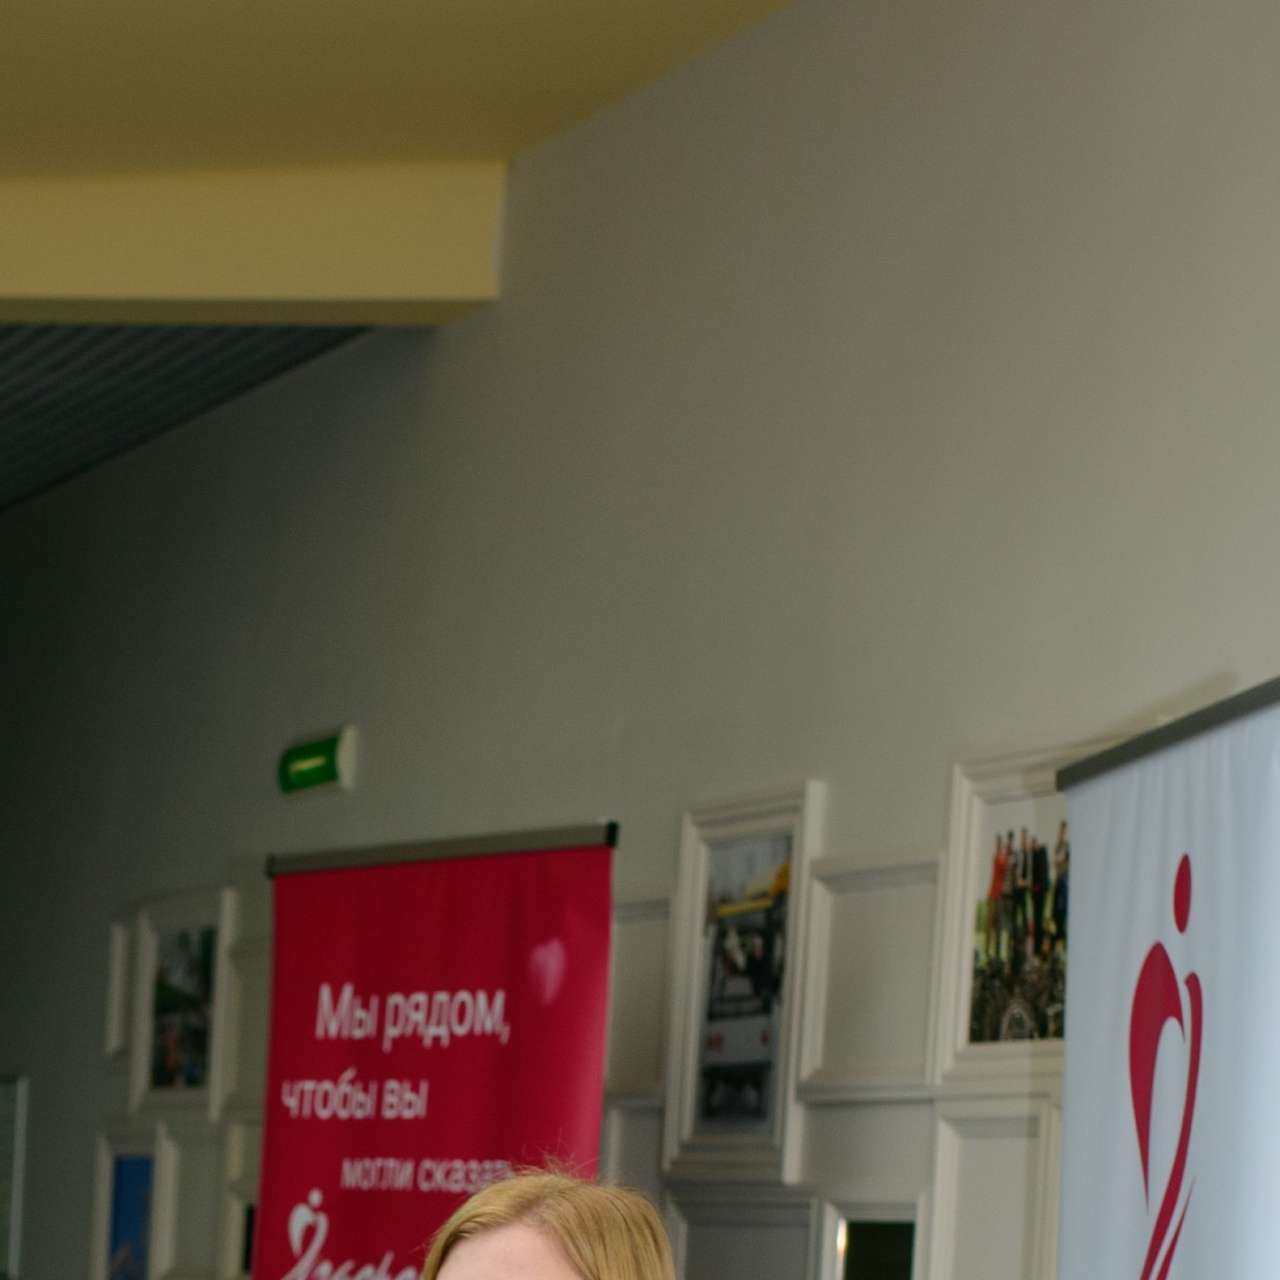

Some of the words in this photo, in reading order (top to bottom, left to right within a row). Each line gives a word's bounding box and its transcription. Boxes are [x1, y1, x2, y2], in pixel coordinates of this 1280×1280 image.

[315, 982, 380, 1040] Мы
[382, 989, 511, 1053] рядом,
[281, 1065, 378, 1120] чтобы
[381, 1079, 429, 1119] вы
[340, 1157, 416, 1191] могли
